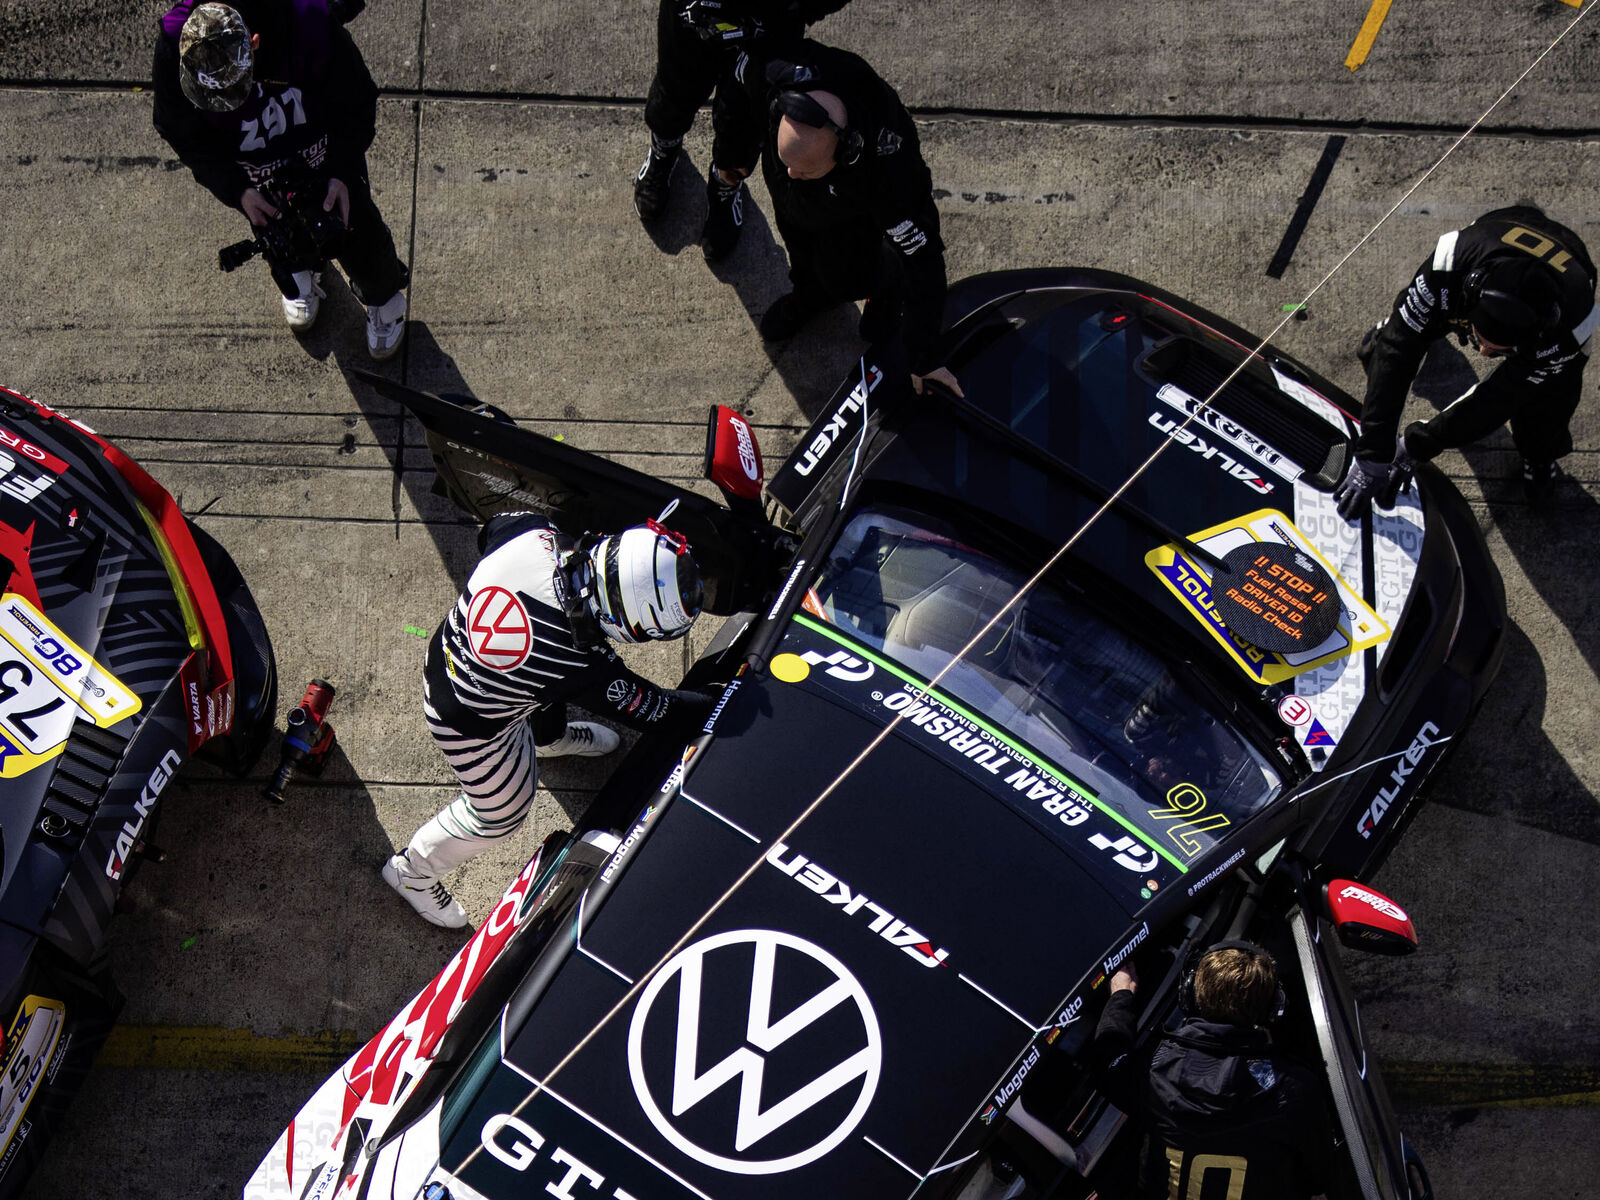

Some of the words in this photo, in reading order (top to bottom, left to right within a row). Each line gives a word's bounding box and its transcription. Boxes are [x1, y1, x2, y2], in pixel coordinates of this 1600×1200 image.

[1501, 226, 1573, 273] 10
[794, 364, 883, 476] FALKEN
[729, 417, 757, 480] Eibach
[1148, 412, 1274, 494] FALKEN
[1241, 582, 1288, 613] DRIVER
[1287, 605, 1304, 623] ID
[1245, 569, 1276, 591] Fuel
[1277, 585, 1313, 614] Reset
[1266, 559, 1314, 596] STOP
[12, 608, 41, 636] RAVENOL
[1225, 588, 1263, 616] Radio
[1262, 608, 1303, 640] Check
[33, 637, 83, 676] 80
[0, 660, 66, 743] 75
[703, 680, 741, 734] Hammel
[903, 683, 979, 733] SIMULATOR
[980, 730, 1034, 768] DRIVING
[661, 763, 685, 794] Otto
[1005, 769, 1090, 827] GRAN
[1037, 766, 1067, 795] REAL
[1069, 790, 1094, 811] THE
[1357, 720, 1440, 840] FALKEN
[105, 749, 183, 880] FALKEN
[1148, 782, 1230, 856] 76
[600, 824, 645, 884] Mogotsi
[766, 842, 949, 967] FALKEN
[1103, 921, 1149, 974] Hammel
[1059, 996, 1083, 1028] Otto
[19, 1056, 44, 1103] 80
[995, 1045, 1041, 1108] Mogotsi
